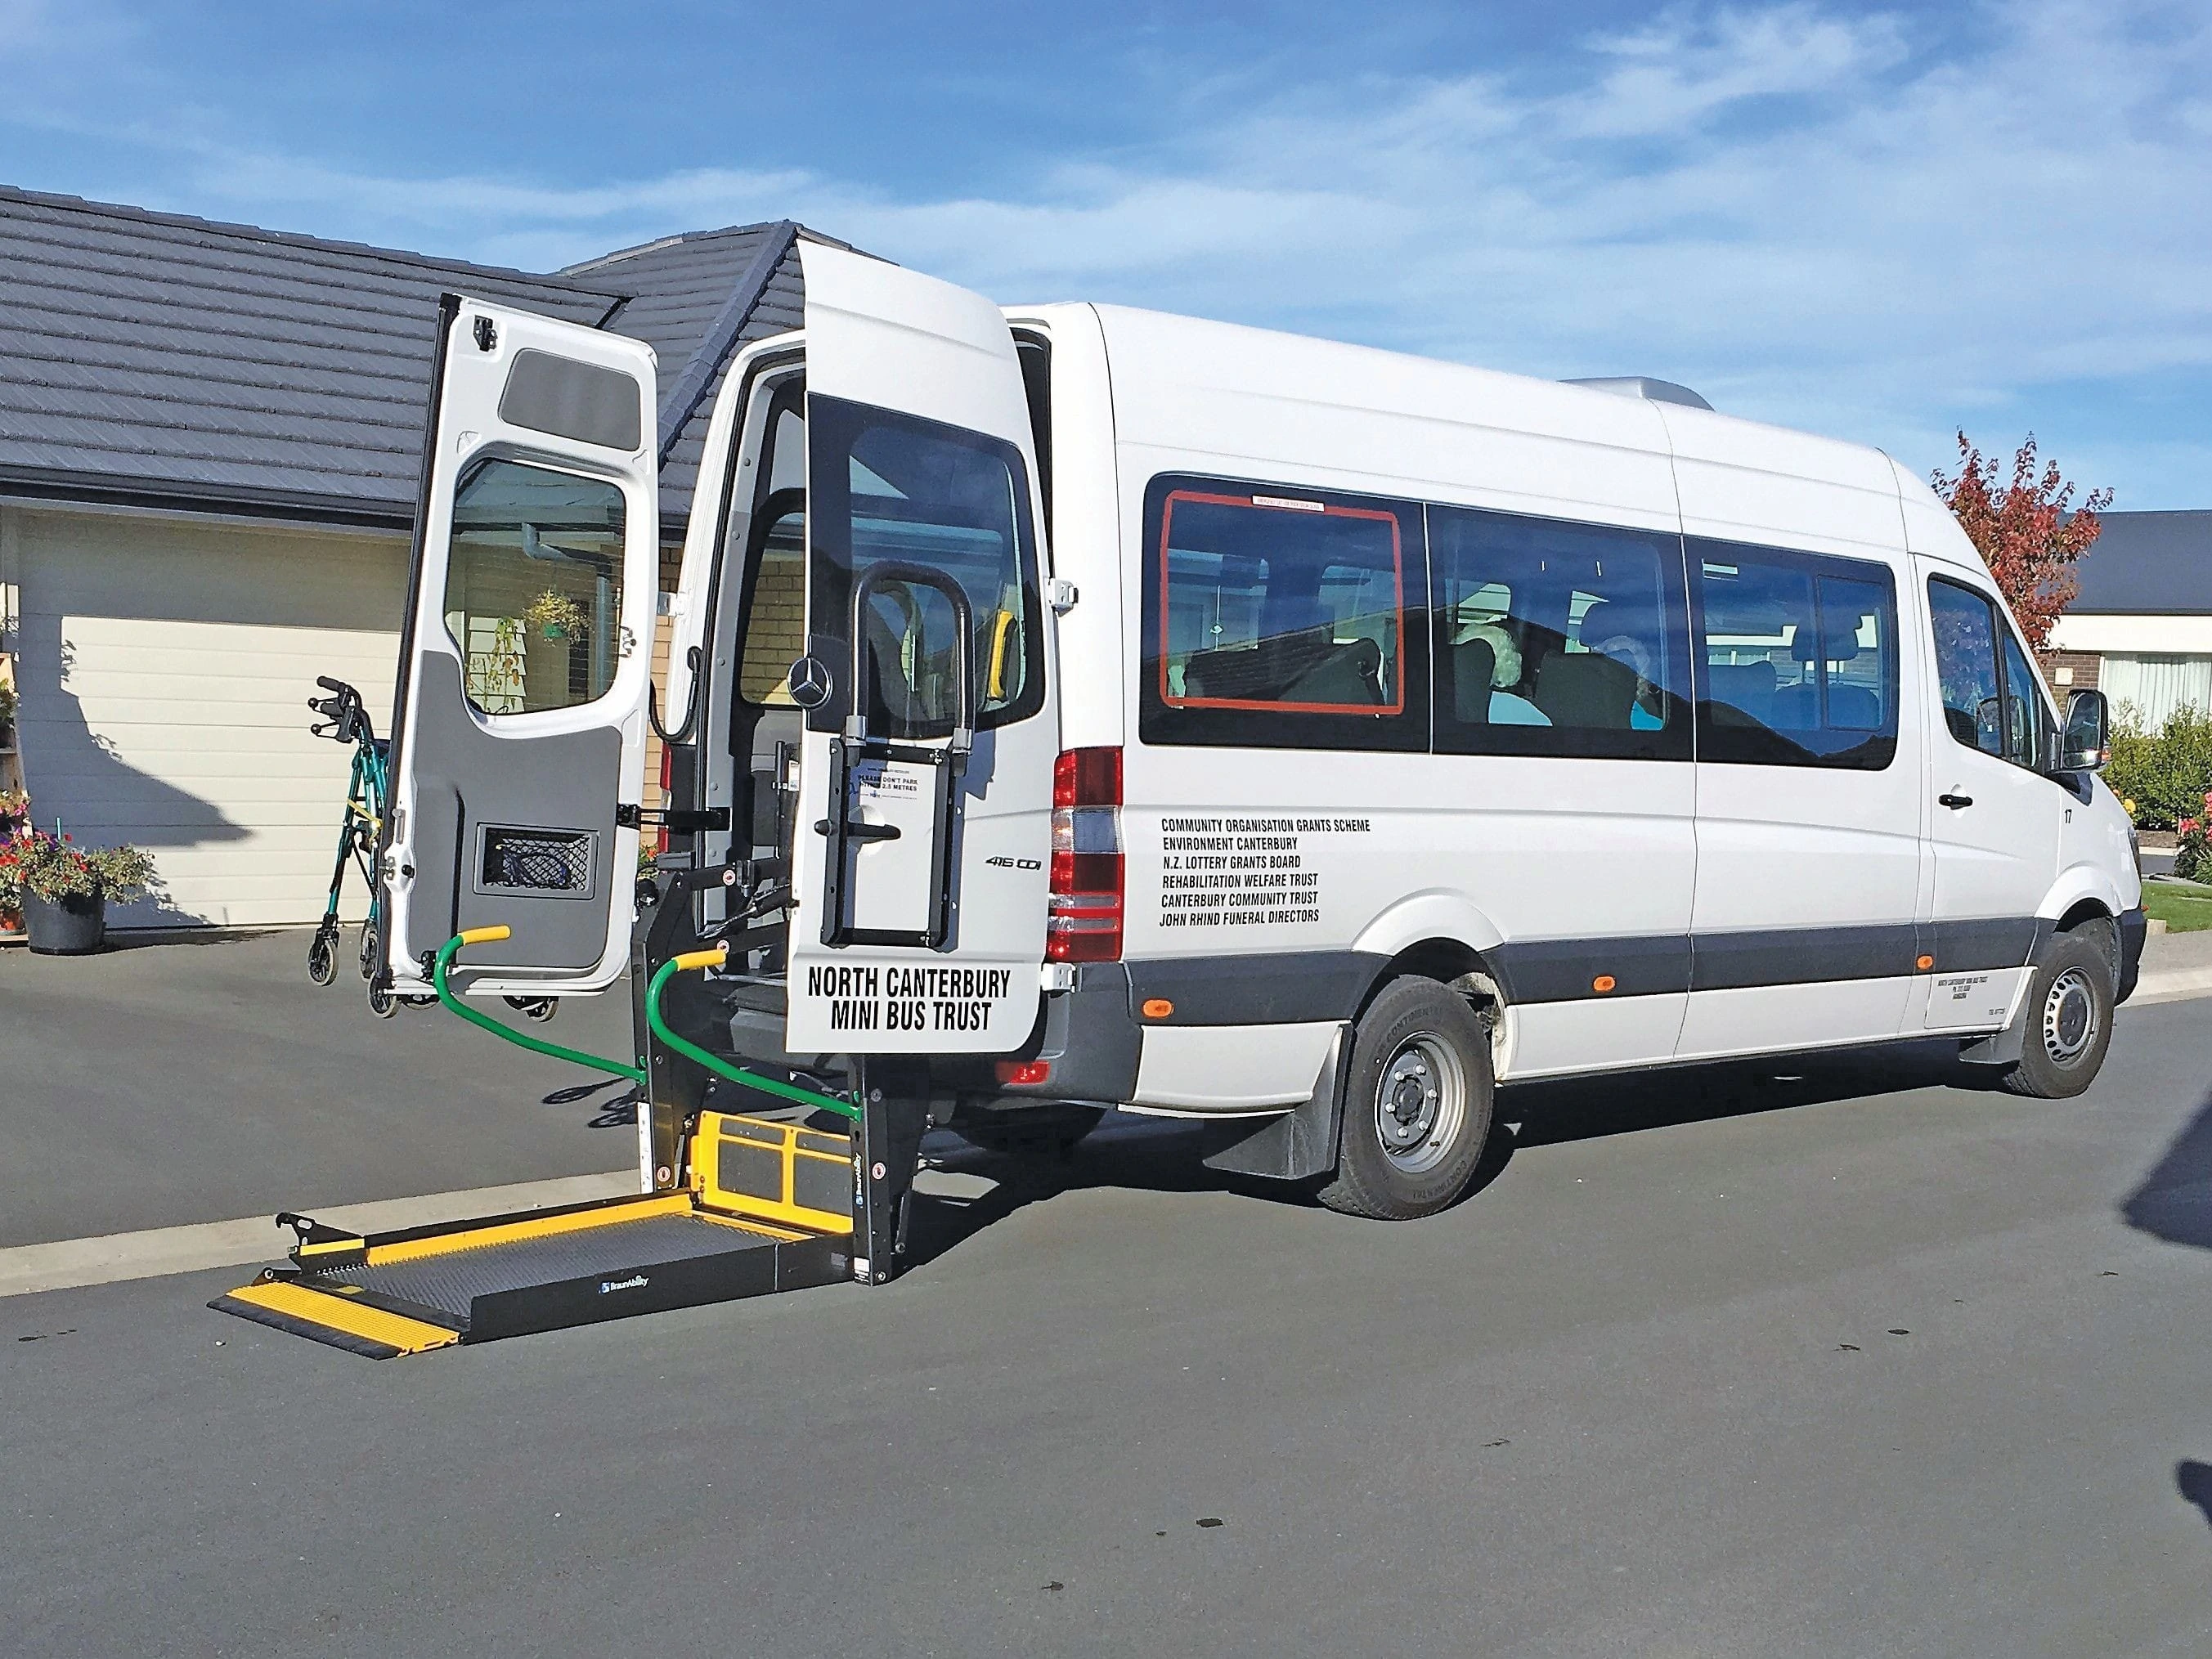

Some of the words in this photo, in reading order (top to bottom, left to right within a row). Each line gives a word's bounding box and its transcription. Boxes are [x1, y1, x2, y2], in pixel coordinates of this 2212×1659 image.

[2065, 809, 2072, 823] 17
[1162, 818, 1222, 832] COMMUNITY
[1226, 819, 1294, 832] ORGANISATION
[1297, 819, 1331, 832] GRANTS
[1334, 819, 1370, 832] SCHEME
[1164, 837, 1233, 850] ENVIRONMENT
[1237, 837, 1297, 850] CANTERBURY
[985, 856, 1014, 867] 416
[1164, 857, 1182, 869] N.Z.
[1187, 856, 1227, 869] LOTTERY
[1231, 856, 1267, 869] GRANTS
[1270, 855, 1300, 868] BOARD
[1163, 875, 1241, 888] REHABILITATION
[1245, 874, 1286, 887] WELFARE
[1290, 873, 1318, 886] TRUST
[1162, 894, 1226, 908] CANTERBURY
[1229, 892, 1286, 906] COMMUNITY
[1290, 891, 1318, 904] TRUST
[1160, 913, 1187, 926] JOHN
[1190, 912, 1219, 926] RHIND
[1223, 912, 1265, 925] FUNERAL
[1268, 909, 1319, 923] DIRECTORS
[809, 966, 877, 997] NORTH
[887, 968, 1010, 998] CANTERBURY
[832, 1001, 878, 1029] MINI
[887, 1001, 925, 1030] BUS
[933, 1002, 991, 1030] TRUST
[610, 1276, 649, 1291] BraunAbility
